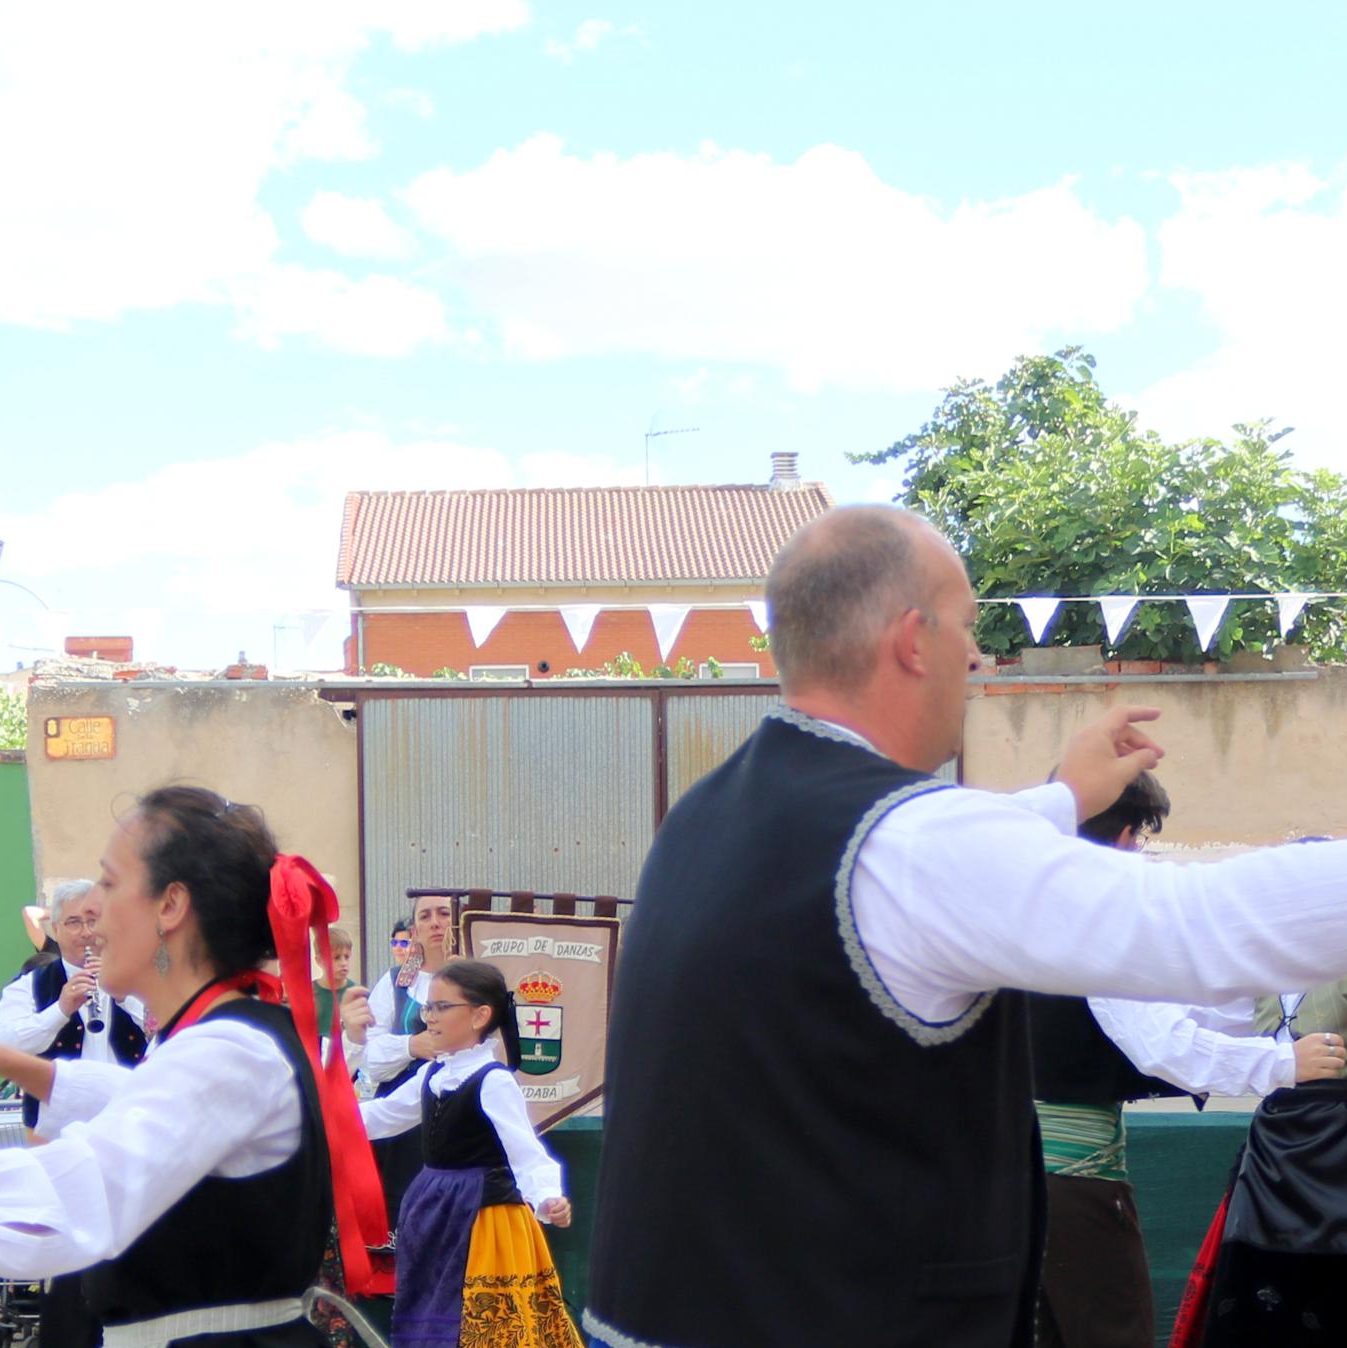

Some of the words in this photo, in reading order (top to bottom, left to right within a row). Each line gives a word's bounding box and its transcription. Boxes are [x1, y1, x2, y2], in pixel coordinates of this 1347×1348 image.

[68, 719, 101, 735] Calle
[490, 940, 525, 954] GRUPO
[534, 939, 549, 952] DE
[556, 944, 595, 958] DANZAS
